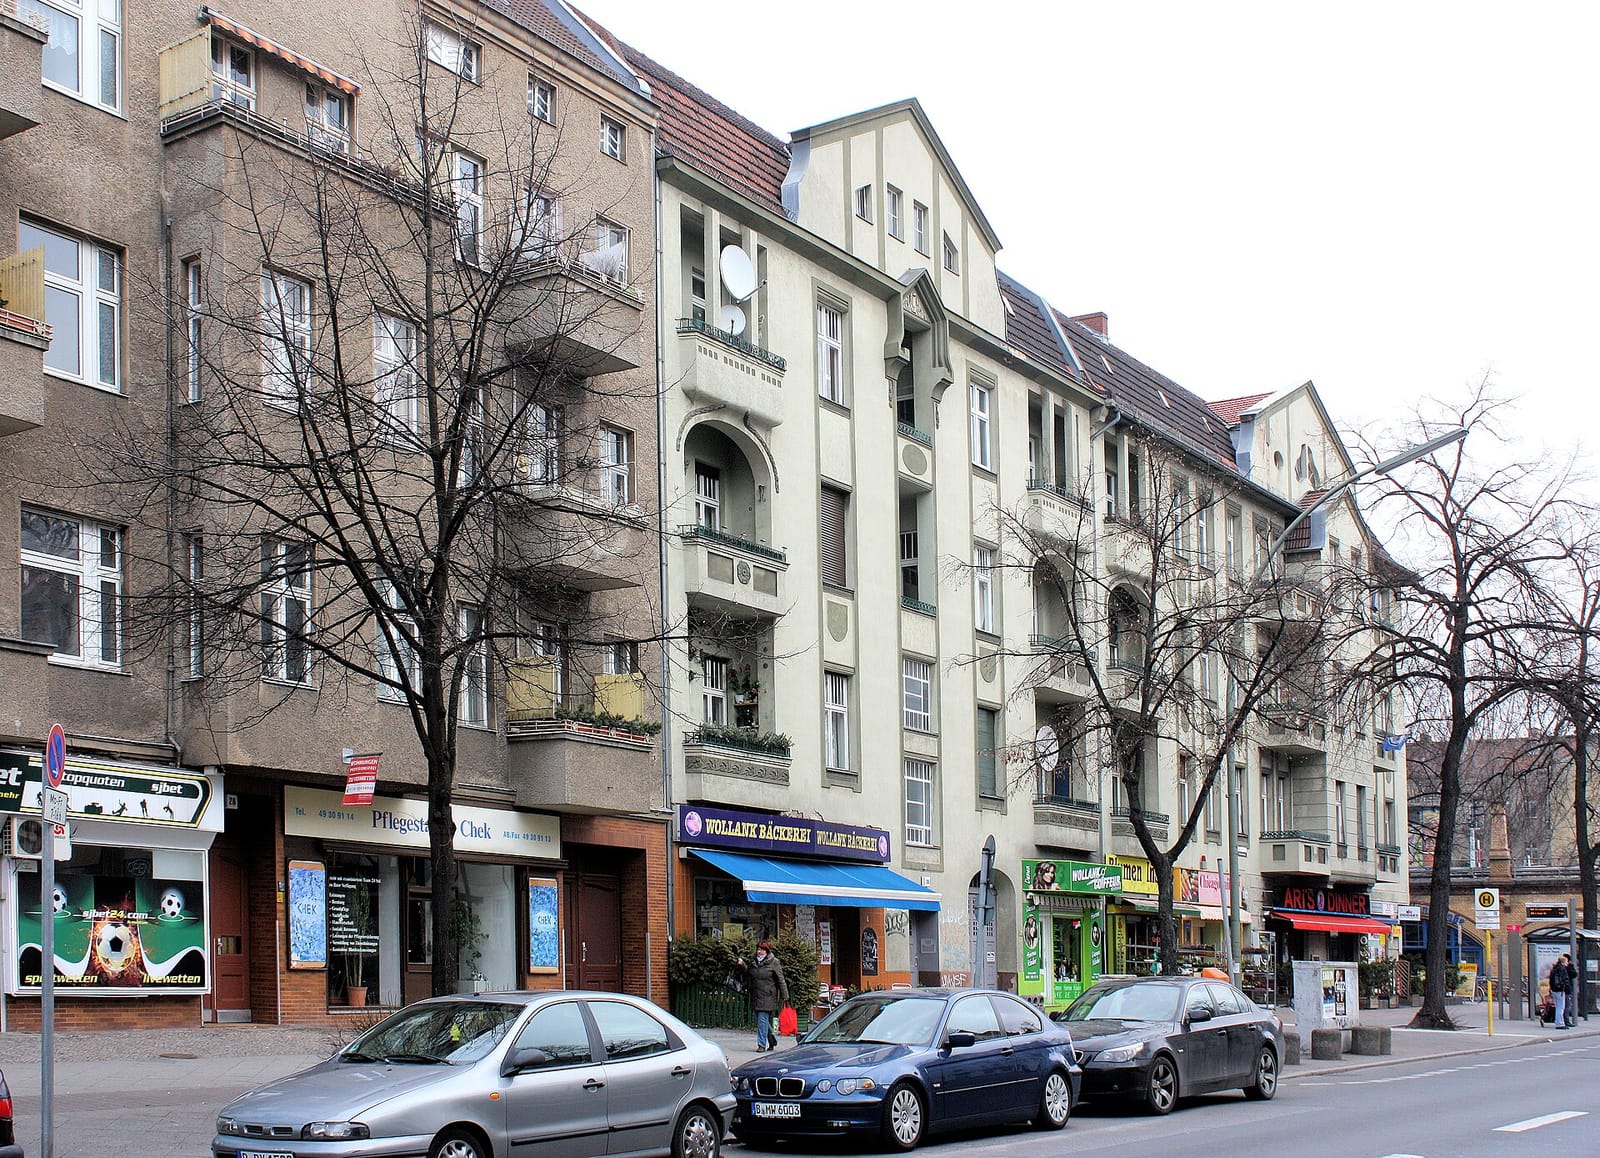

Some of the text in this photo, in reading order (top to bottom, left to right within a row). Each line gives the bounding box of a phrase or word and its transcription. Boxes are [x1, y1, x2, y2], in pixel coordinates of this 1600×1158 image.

[151, 781, 183, 794] sjbet
[460, 819, 491, 839] Chek
[705, 818, 811, 844] WOLLANK BÄCKEREI
[816, 830, 878, 852] WOLLANK BÄCKEREI
[1072, 867, 1102, 882] WOLLANK
[1093, 875, 1121, 890] COIFFEUR
[1327, 892, 1367, 914] DINNER
[82, 909, 148, 919] sjbet24.com
[25, 974, 98, 985] sptwetten
[143, 974, 200, 984] livewetten
[778, 1104, 800, 1116] 6003
